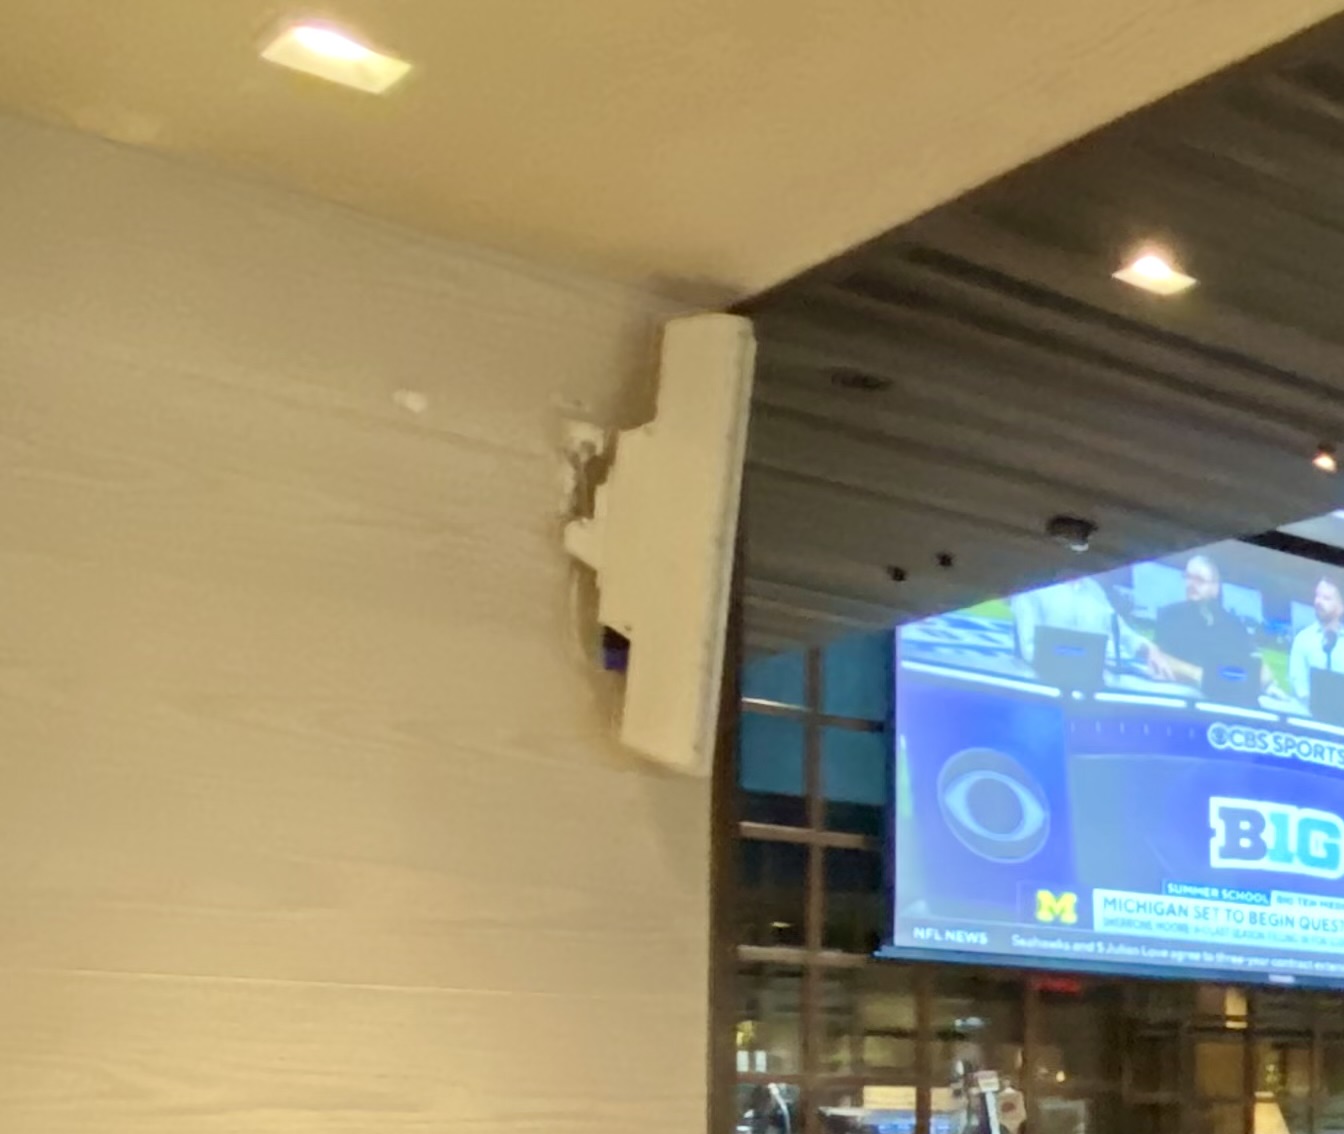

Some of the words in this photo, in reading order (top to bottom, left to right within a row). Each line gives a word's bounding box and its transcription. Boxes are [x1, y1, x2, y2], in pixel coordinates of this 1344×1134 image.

[1229, 728, 1269, 751] CBS
[1167, 882, 1219, 898] SUMMER
[1221, 888, 1269, 905] SCHOOL
[1035, 889, 1078, 924] M
[1103, 896, 1188, 918] MICHIGAN
[1193, 906, 1219, 921] SET
[1224, 908, 1245, 924] TO
[1249, 911, 1295, 929] BEGIN
[913, 926, 943, 941] NFL
[944, 930, 988, 945] NEWS
[1072, 940, 1095, 952] and
